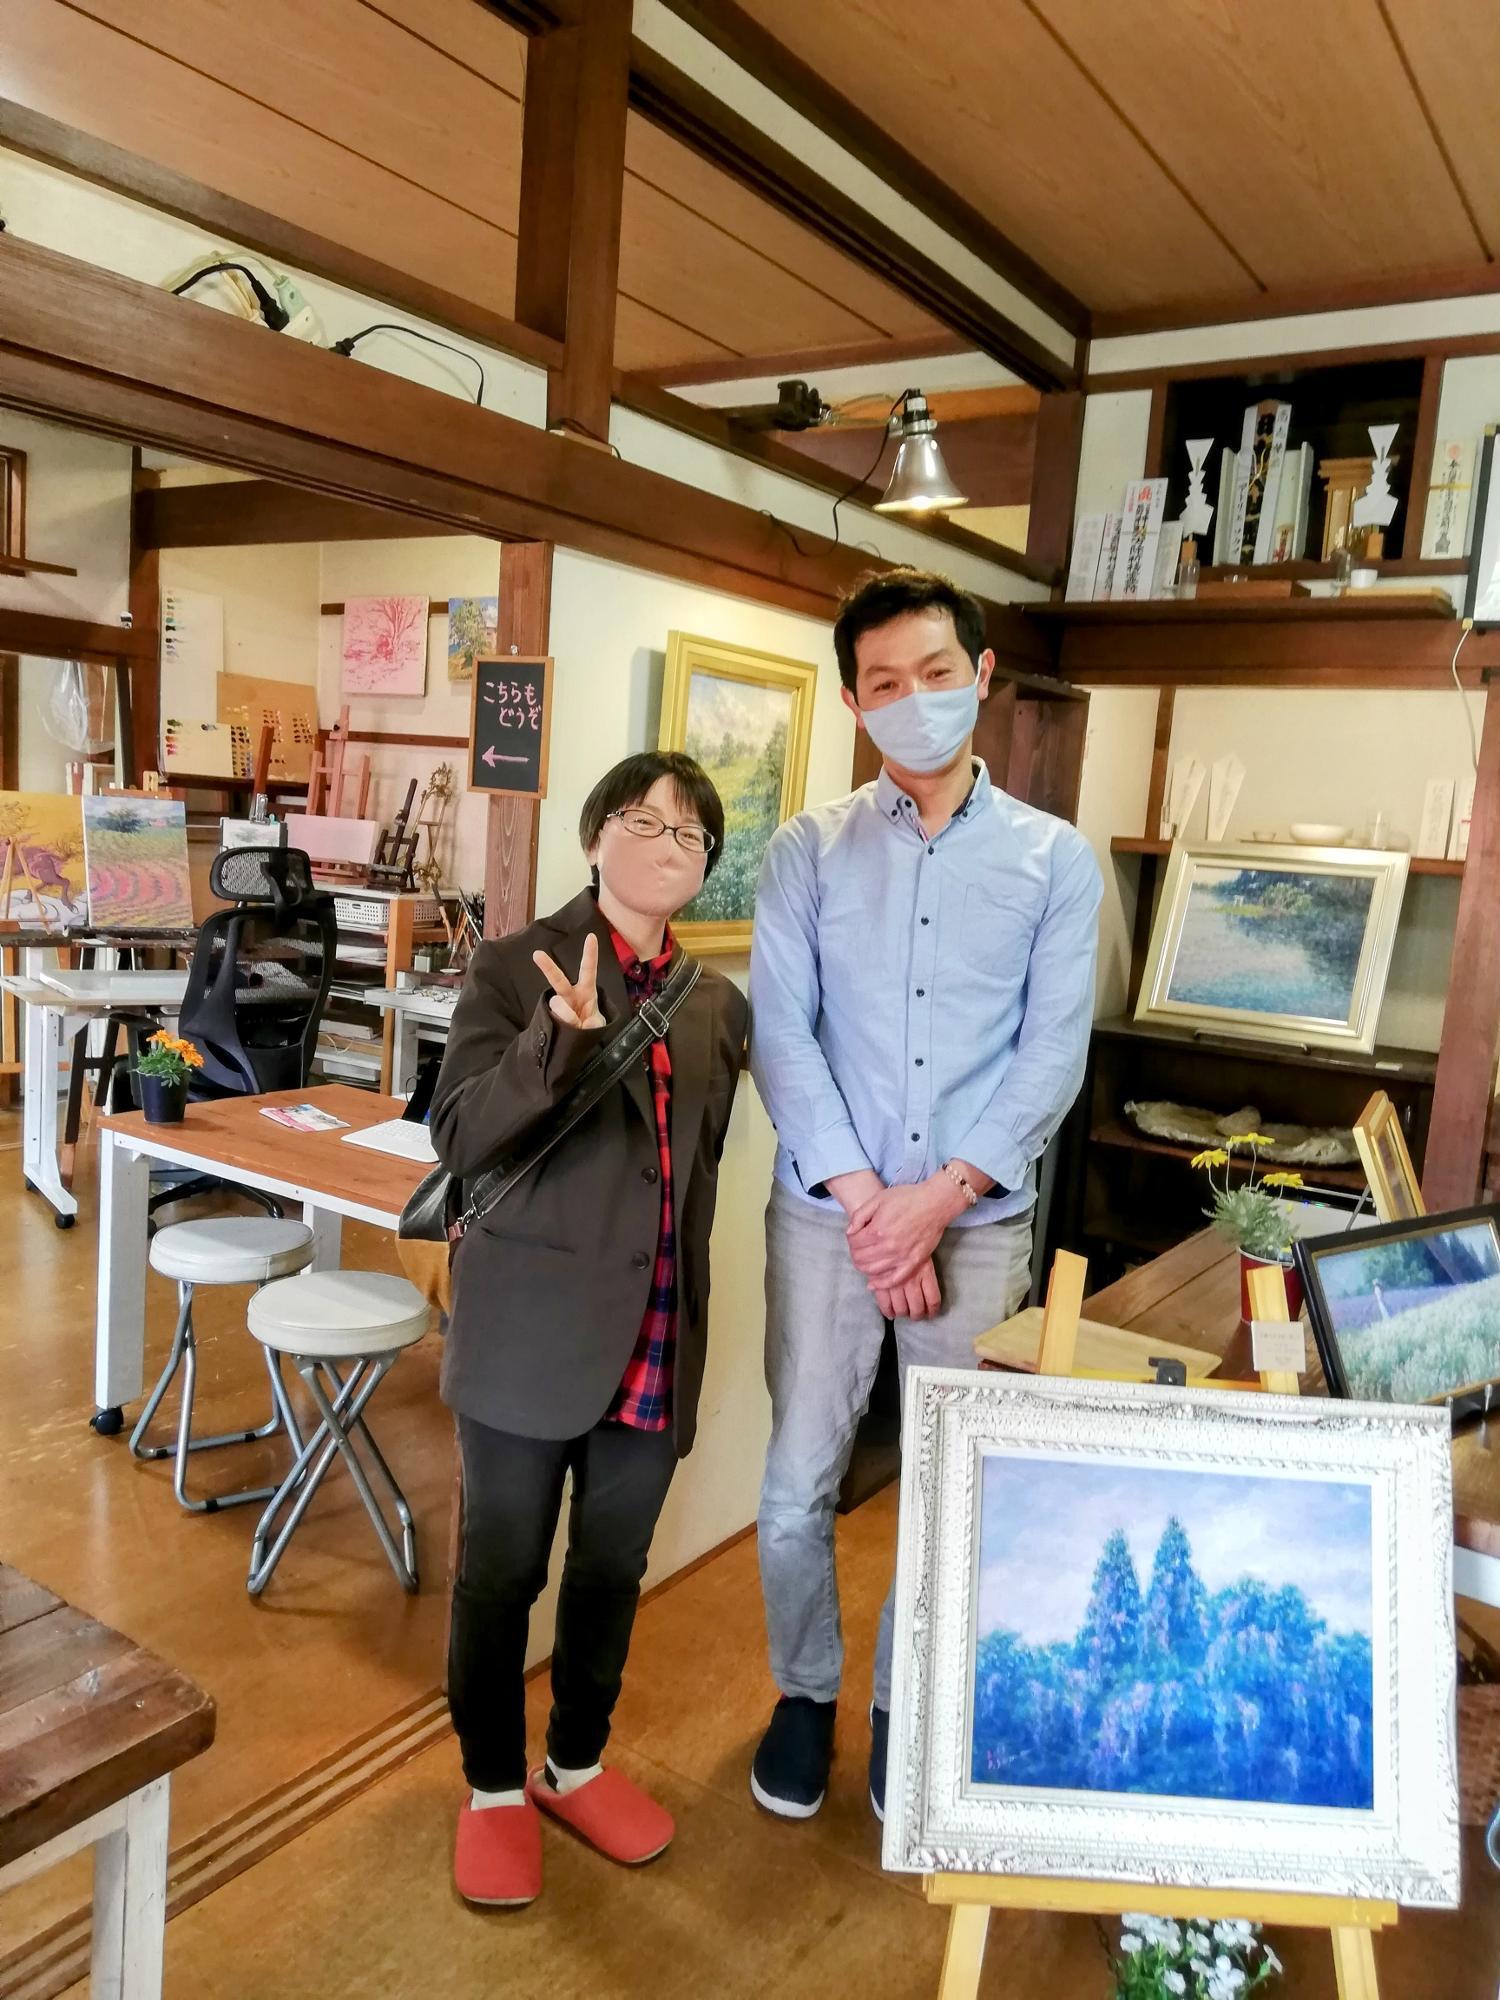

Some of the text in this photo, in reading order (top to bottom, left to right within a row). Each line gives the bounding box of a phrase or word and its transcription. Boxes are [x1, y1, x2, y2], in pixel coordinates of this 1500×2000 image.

[483, 681, 537, 706] こちらも
[498, 704, 542, 731] どうぞ
